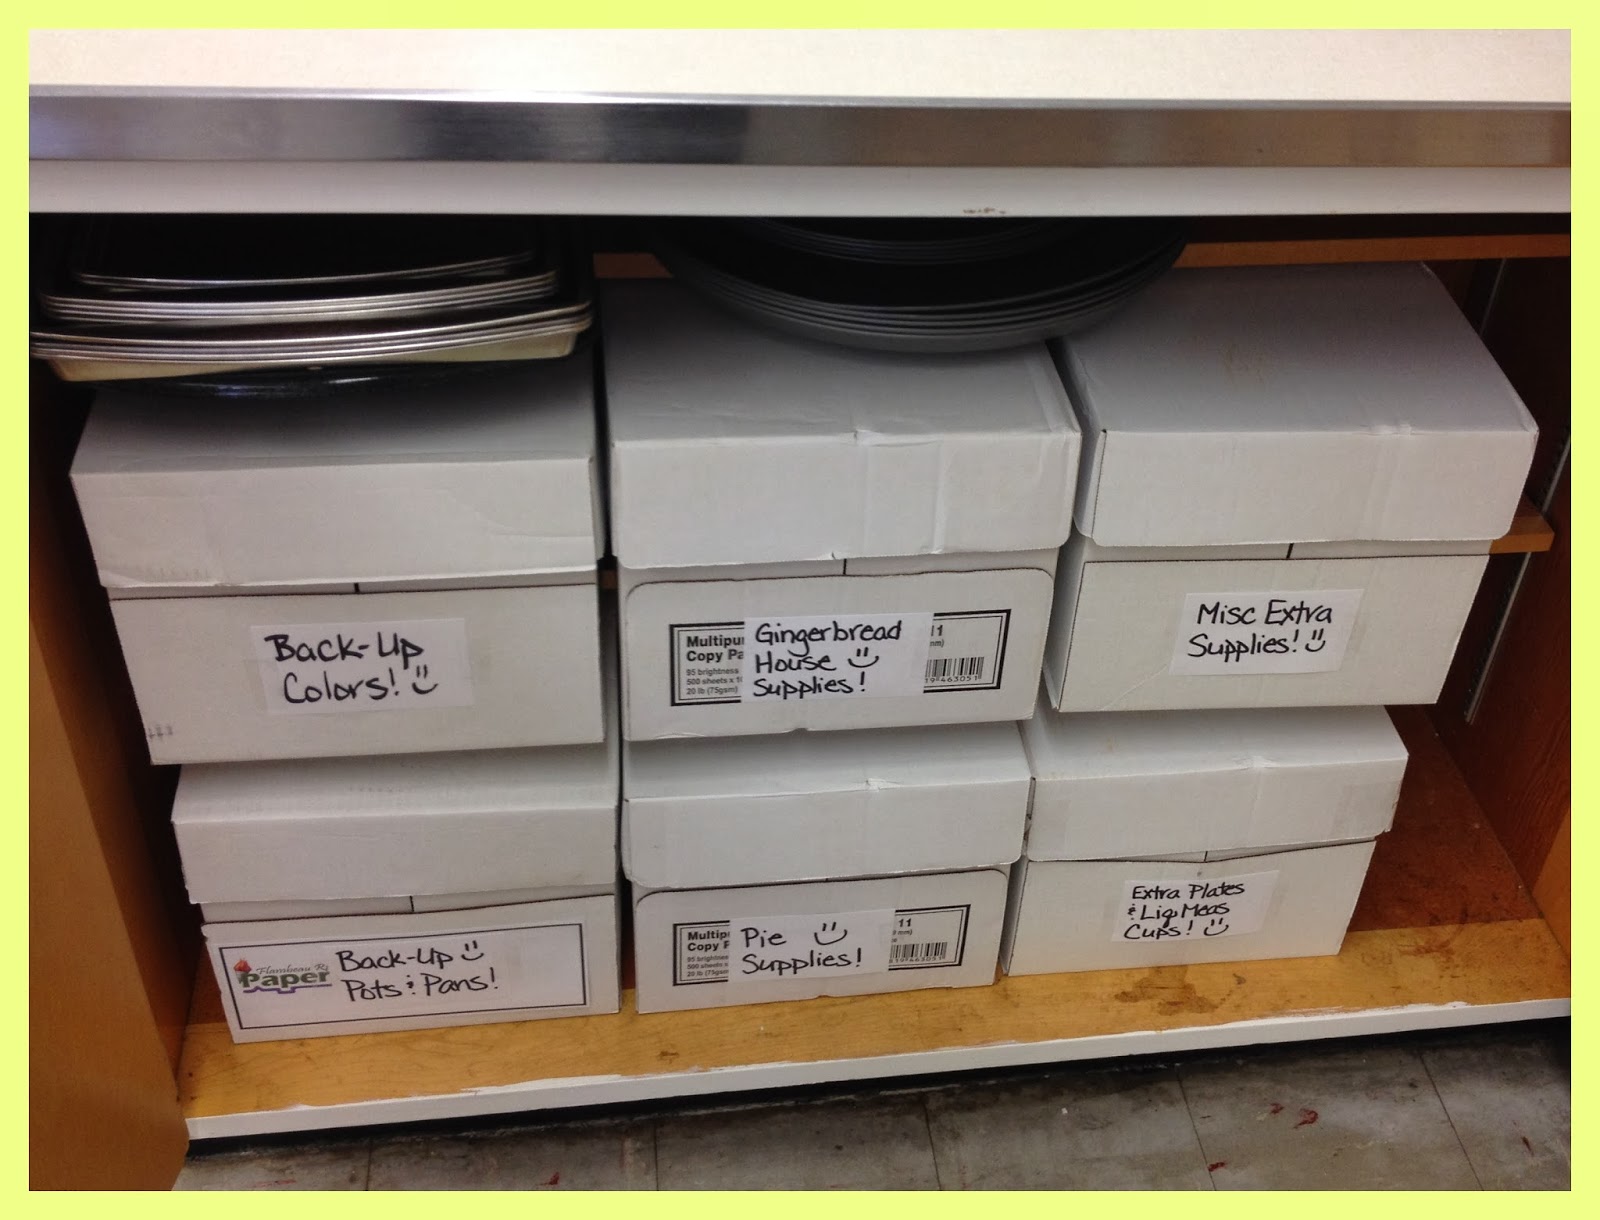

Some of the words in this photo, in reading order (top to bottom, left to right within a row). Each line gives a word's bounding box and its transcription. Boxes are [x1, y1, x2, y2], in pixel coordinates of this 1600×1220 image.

[1196, 601, 1257, 625] Misc
[1264, 599, 1333, 626] Extra
[755, 620, 903, 657] Gingerbread
[1187, 628, 1300, 663] Supplies!
[263, 631, 425, 671] Back-Up
[686, 650, 723, 664] Copy
[697, 667, 740, 677] brightness
[754, 650, 838, 674] House
[283, 667, 400, 703] Colors!
[686, 677, 701, 686] 500
[702, 677, 728, 685] sheets
[686, 687, 697, 695] 20
[697, 687, 706, 695] lb
[1132, 885, 1181, 900] Extra
[1187, 881, 1246, 900] Plates
[1180, 902, 1231, 919] Meas
[898, 918, 912, 928] 11
[687, 942, 720, 952] Copy
[740, 927, 787, 948] Pie
[255, 964, 311, 975] Flambeau
[336, 948, 454, 972] Back-Up
[741, 947, 862, 976] Supplies!
[239, 971, 330, 989] Paper
[340, 979, 404, 1002] Pots
[420, 967, 500, 997] Pans!
